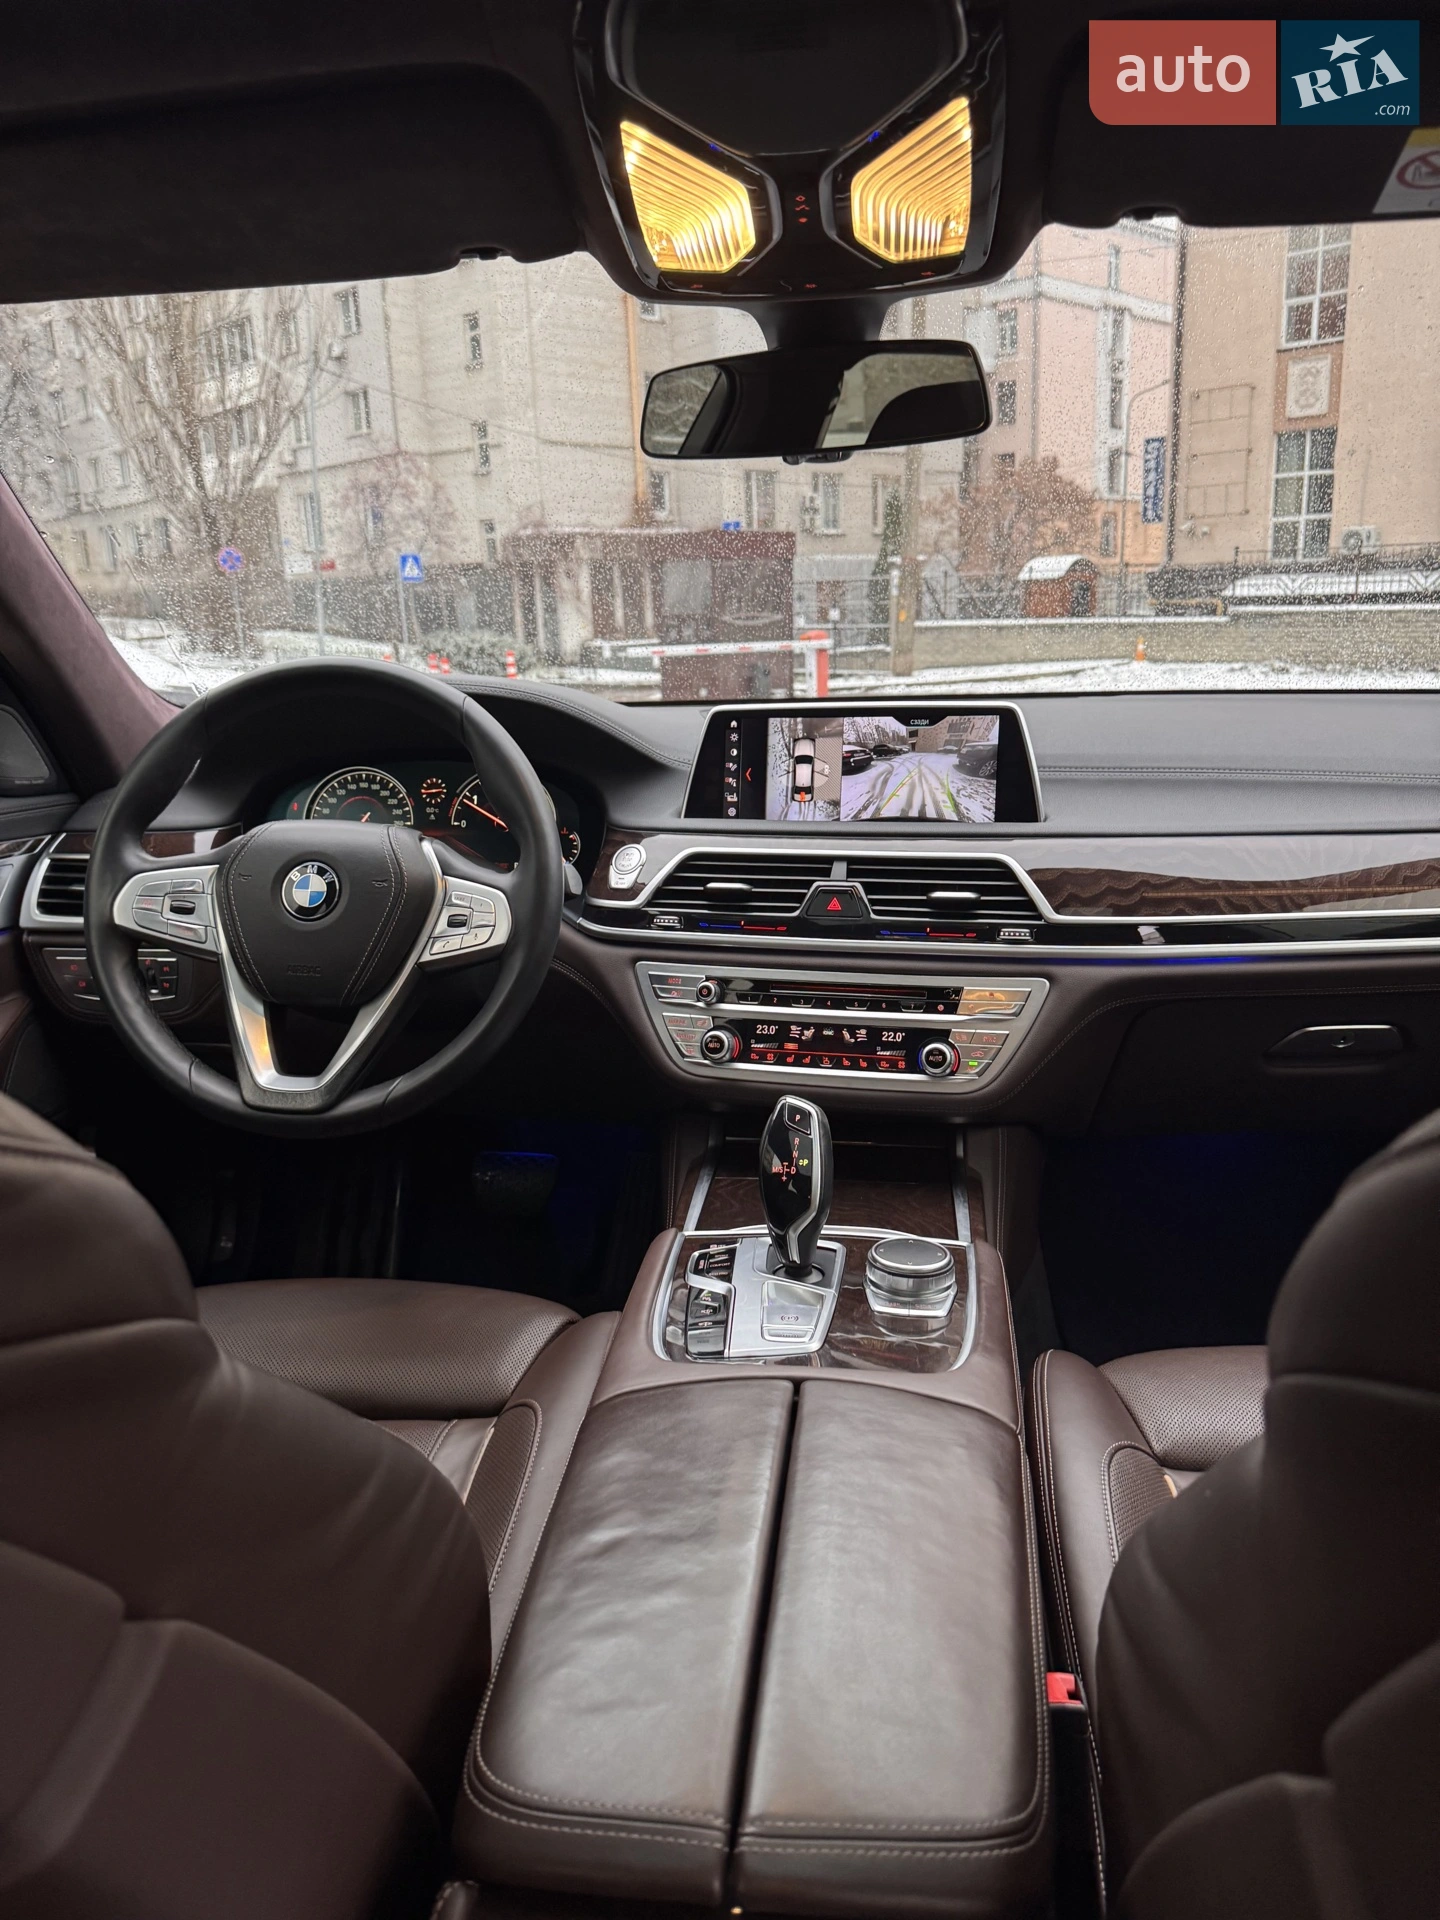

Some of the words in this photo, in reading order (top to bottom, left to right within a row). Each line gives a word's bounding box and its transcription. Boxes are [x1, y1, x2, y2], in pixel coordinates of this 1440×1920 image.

[472, 795, 478, 805] 1
[460, 820, 467, 828] 0
[290, 864, 335, 883] BMW
[795, 1114, 801, 1122] P
[794, 1137, 800, 1145] R
[792, 1150, 799, 1158] N
[772, 1166, 784, 1174] M/S
[790, 1167, 797, 1175] D
